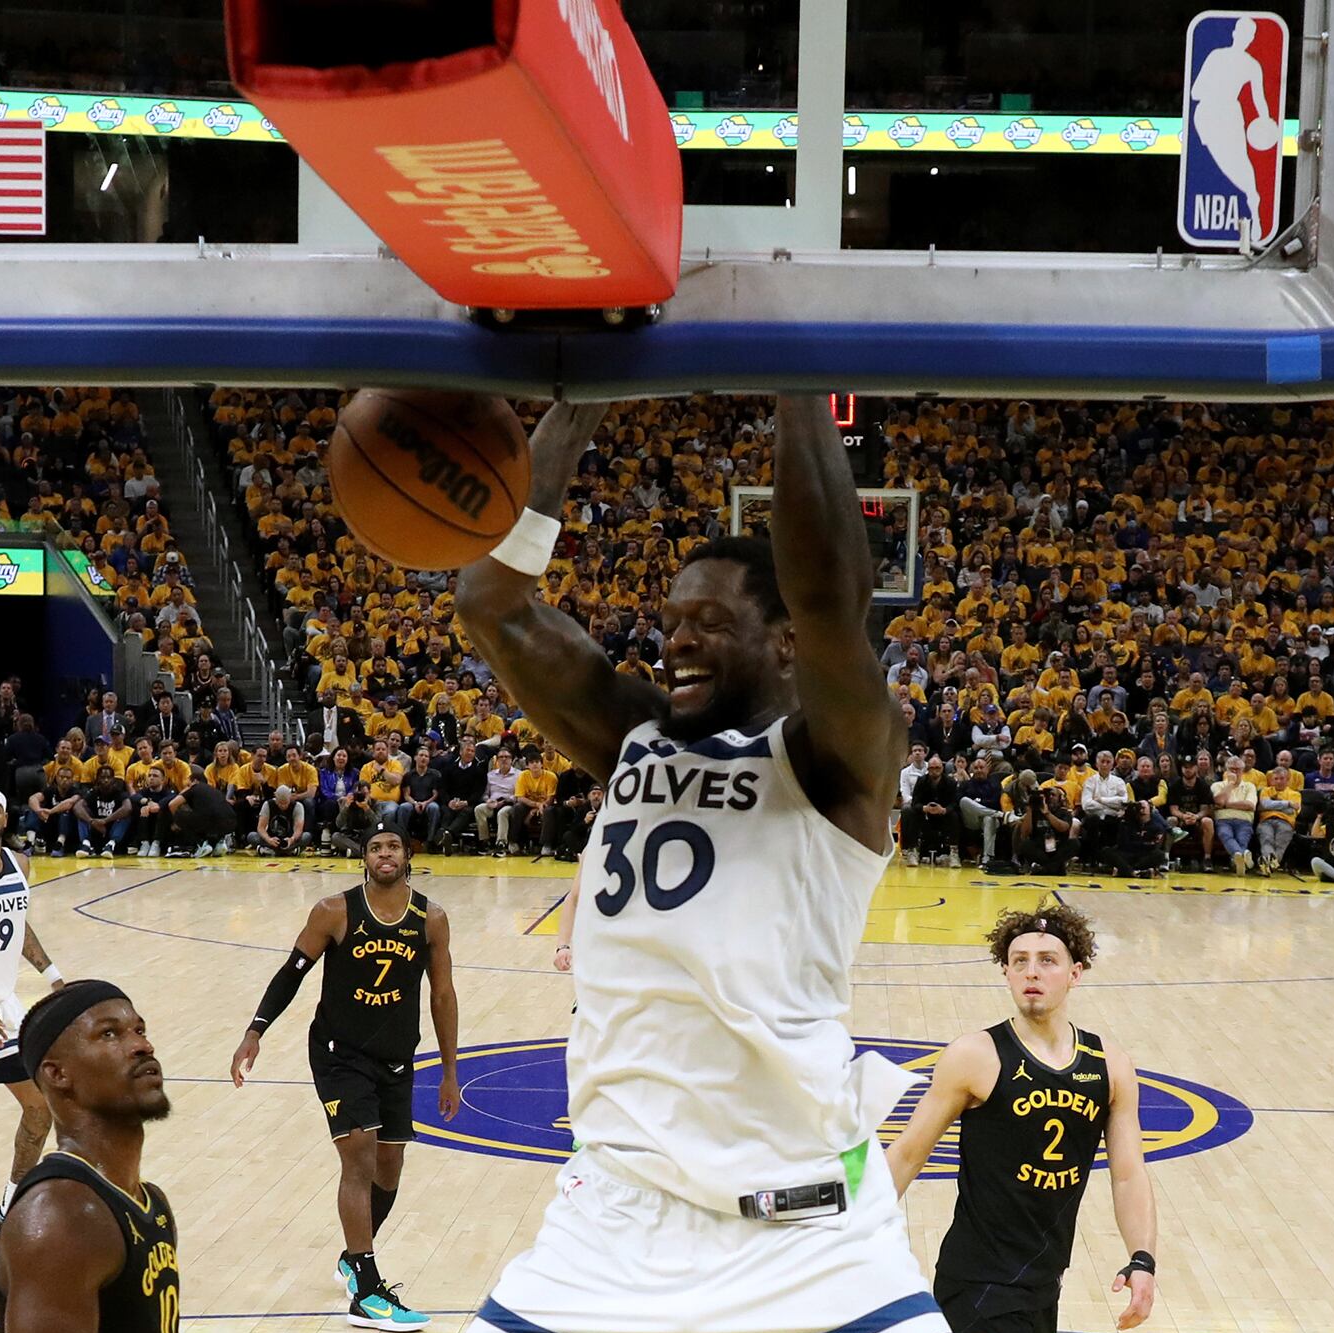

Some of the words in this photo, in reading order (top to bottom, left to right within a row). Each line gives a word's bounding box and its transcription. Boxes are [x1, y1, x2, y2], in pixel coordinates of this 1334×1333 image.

[27, 97, 68, 124] Starry
[86, 100, 127, 127] Starry
[145, 103, 186, 130] Starry
[202, 105, 243, 133] Starry
[1194, 193, 1240, 231] NBA
[378, 411, 492, 521] Wilson
[605, 764, 760, 812] OLVES
[595, 819, 715, 917] 30
[352, 939, 416, 961] GOLDEN
[373, 959, 392, 987] 7
[354, 988, 401, 1006] STATE
[1012, 1088, 1100, 1122] GOLDEN
[1042, 1118, 1065, 1160] 2
[1017, 1163, 1080, 1190] STATE
